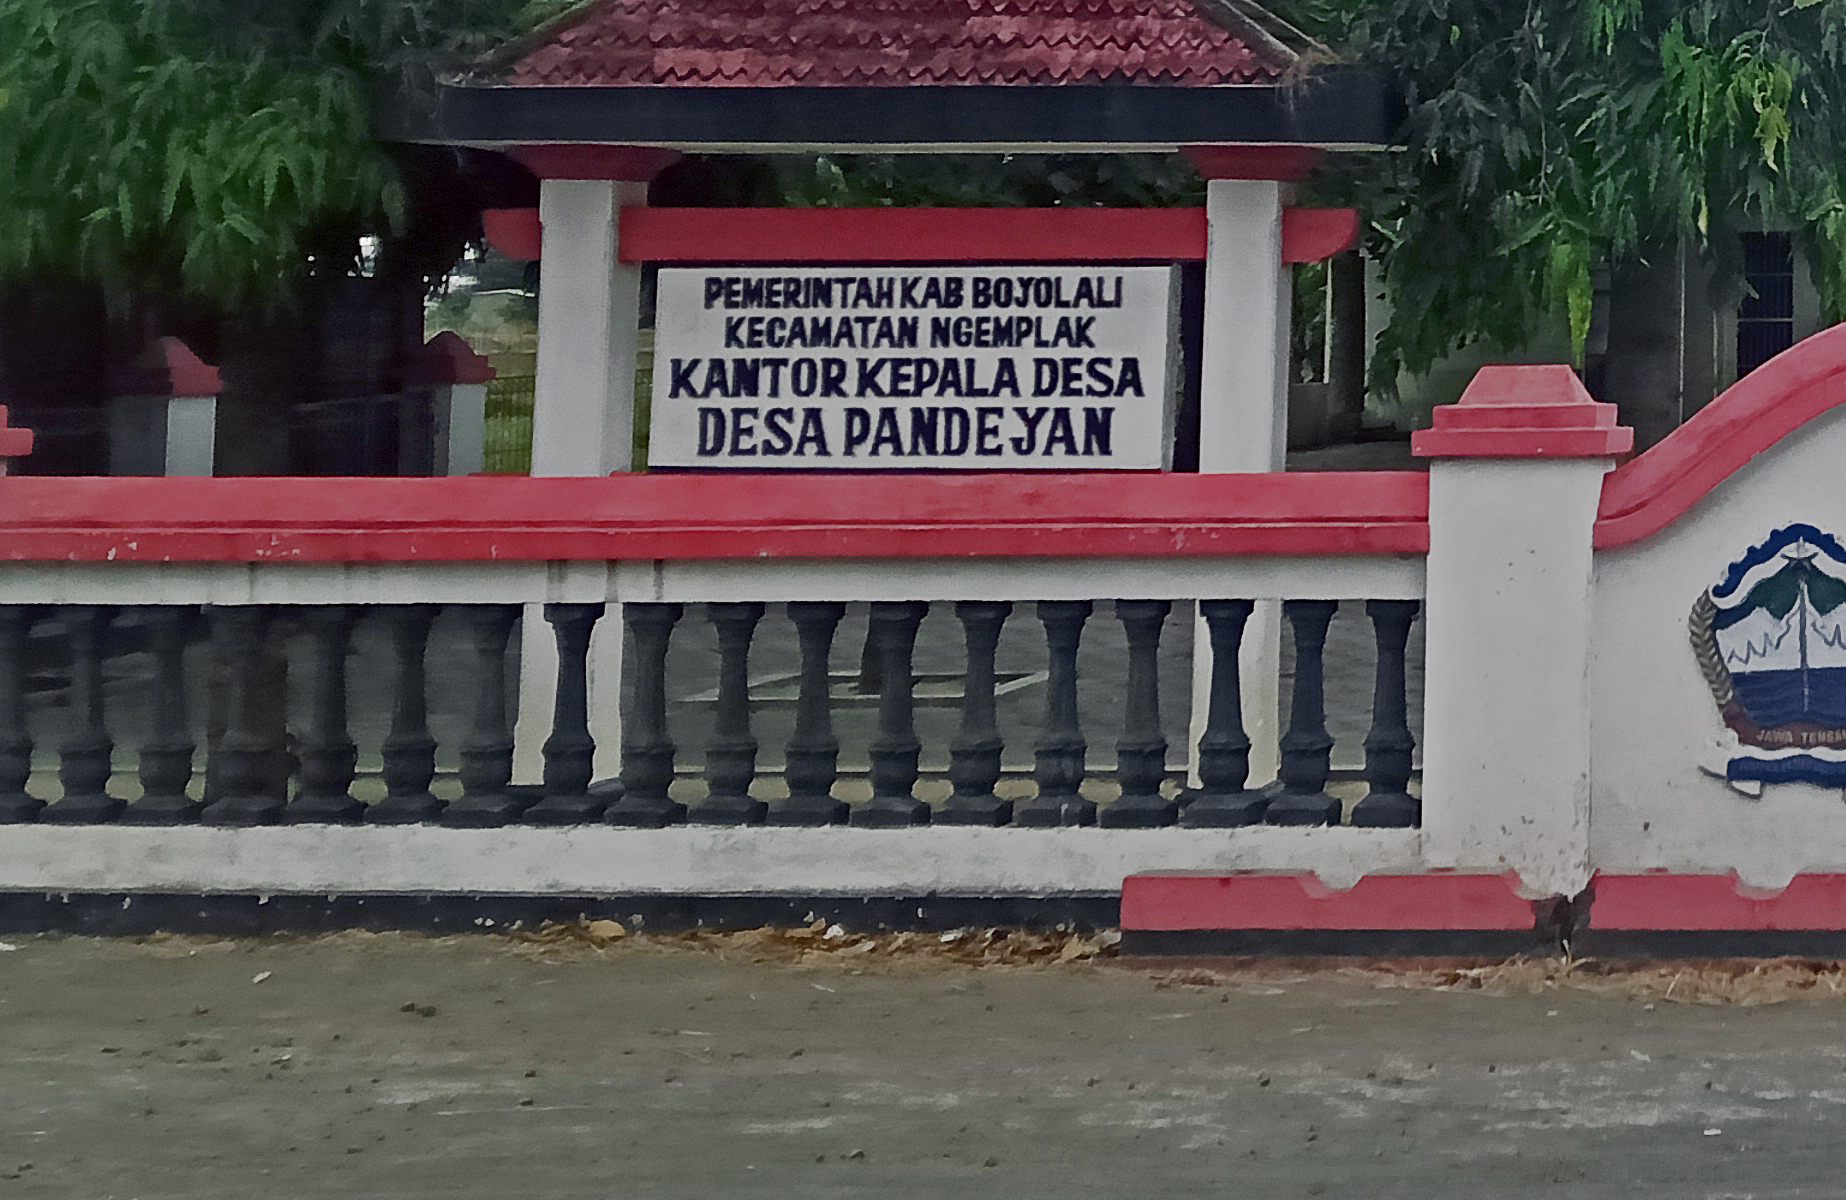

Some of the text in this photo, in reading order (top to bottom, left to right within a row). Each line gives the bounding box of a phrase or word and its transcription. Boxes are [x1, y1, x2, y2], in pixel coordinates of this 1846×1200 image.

[703, 276, 1124, 310] PEMERINTAH KAB BOYOLALI
[724, 315, 1097, 349] KECAMATAN NGEMPLAK
[667, 357, 1146, 399] KANTOR KEPALA DESA
[697, 406, 1116, 457] DESA PANDEYAN
[1756, 729, 1793, 743] JAWA
